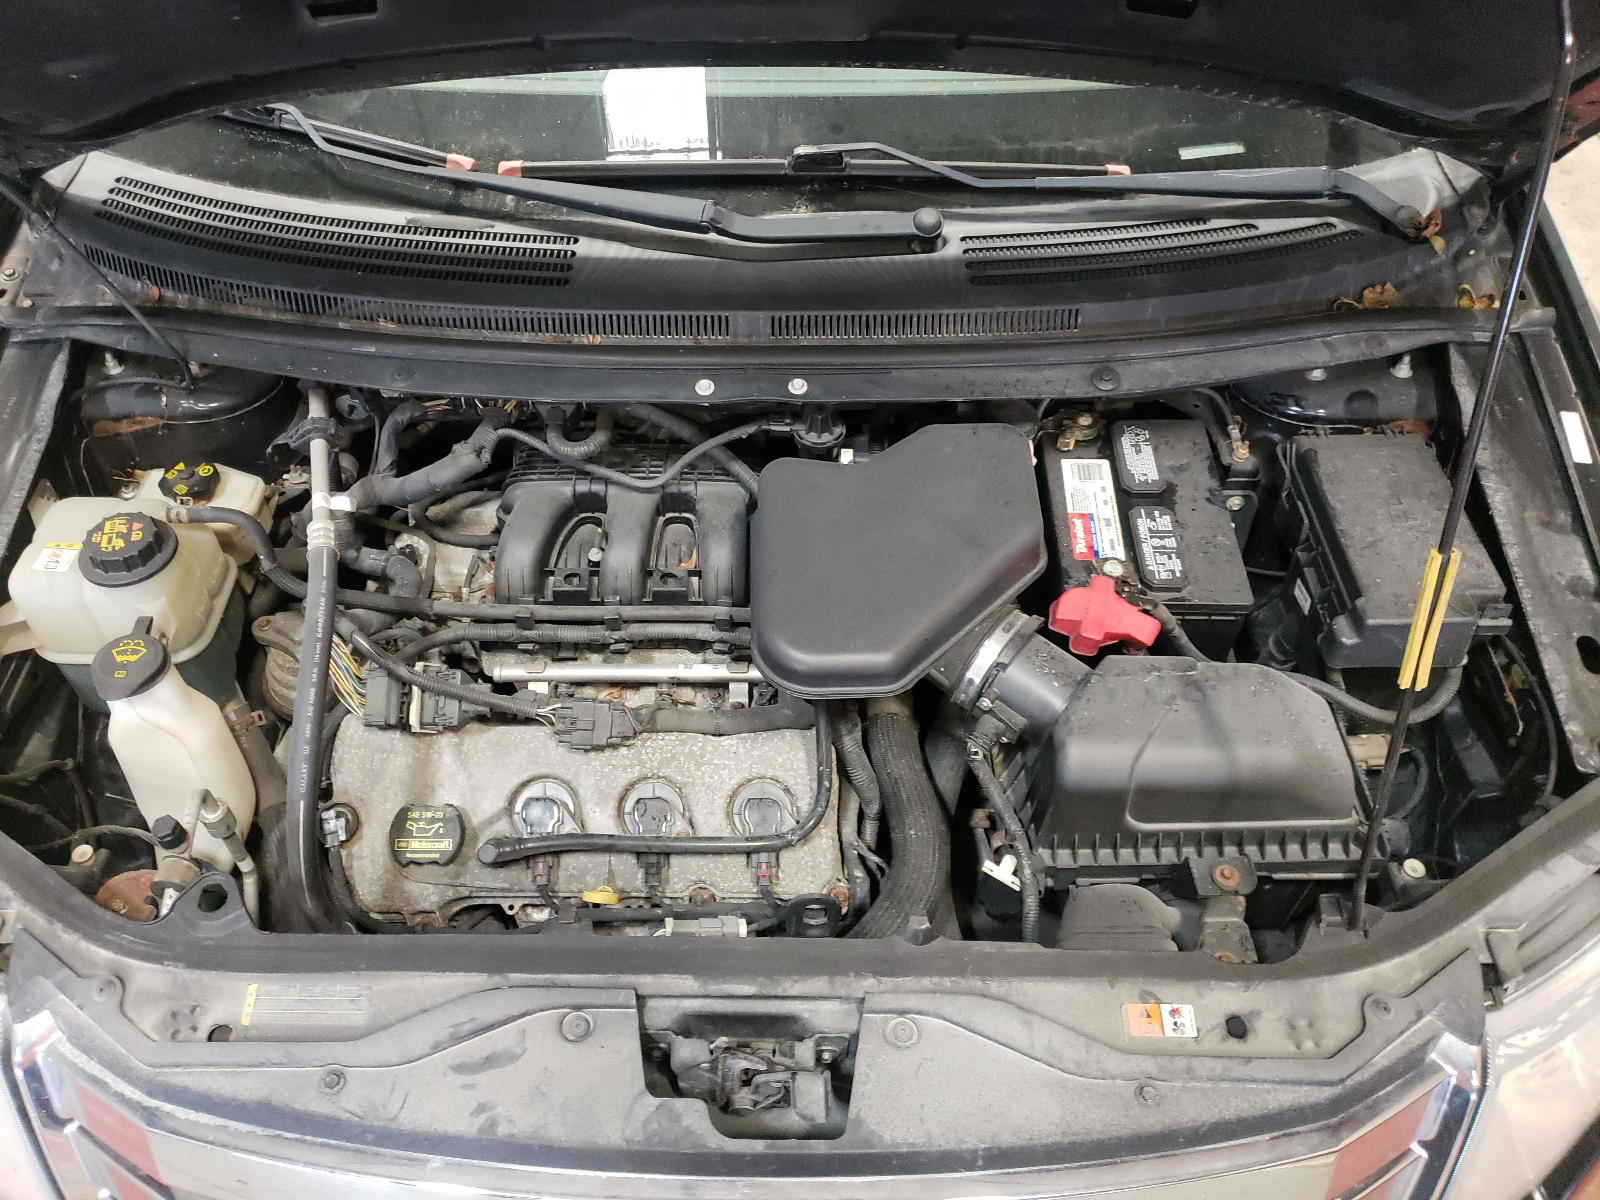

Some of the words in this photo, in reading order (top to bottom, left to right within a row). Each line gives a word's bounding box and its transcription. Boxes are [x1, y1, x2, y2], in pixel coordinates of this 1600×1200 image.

[1072, 518, 1088, 554] Duralast
[300, 763, 308, 793] GALAXY
[317, 597, 326, 638] GOODYEAR
[407, 811, 421, 819] SAE
[422, 811, 444, 819] 5W-20
[410, 841, 449, 849] Motorcraft
